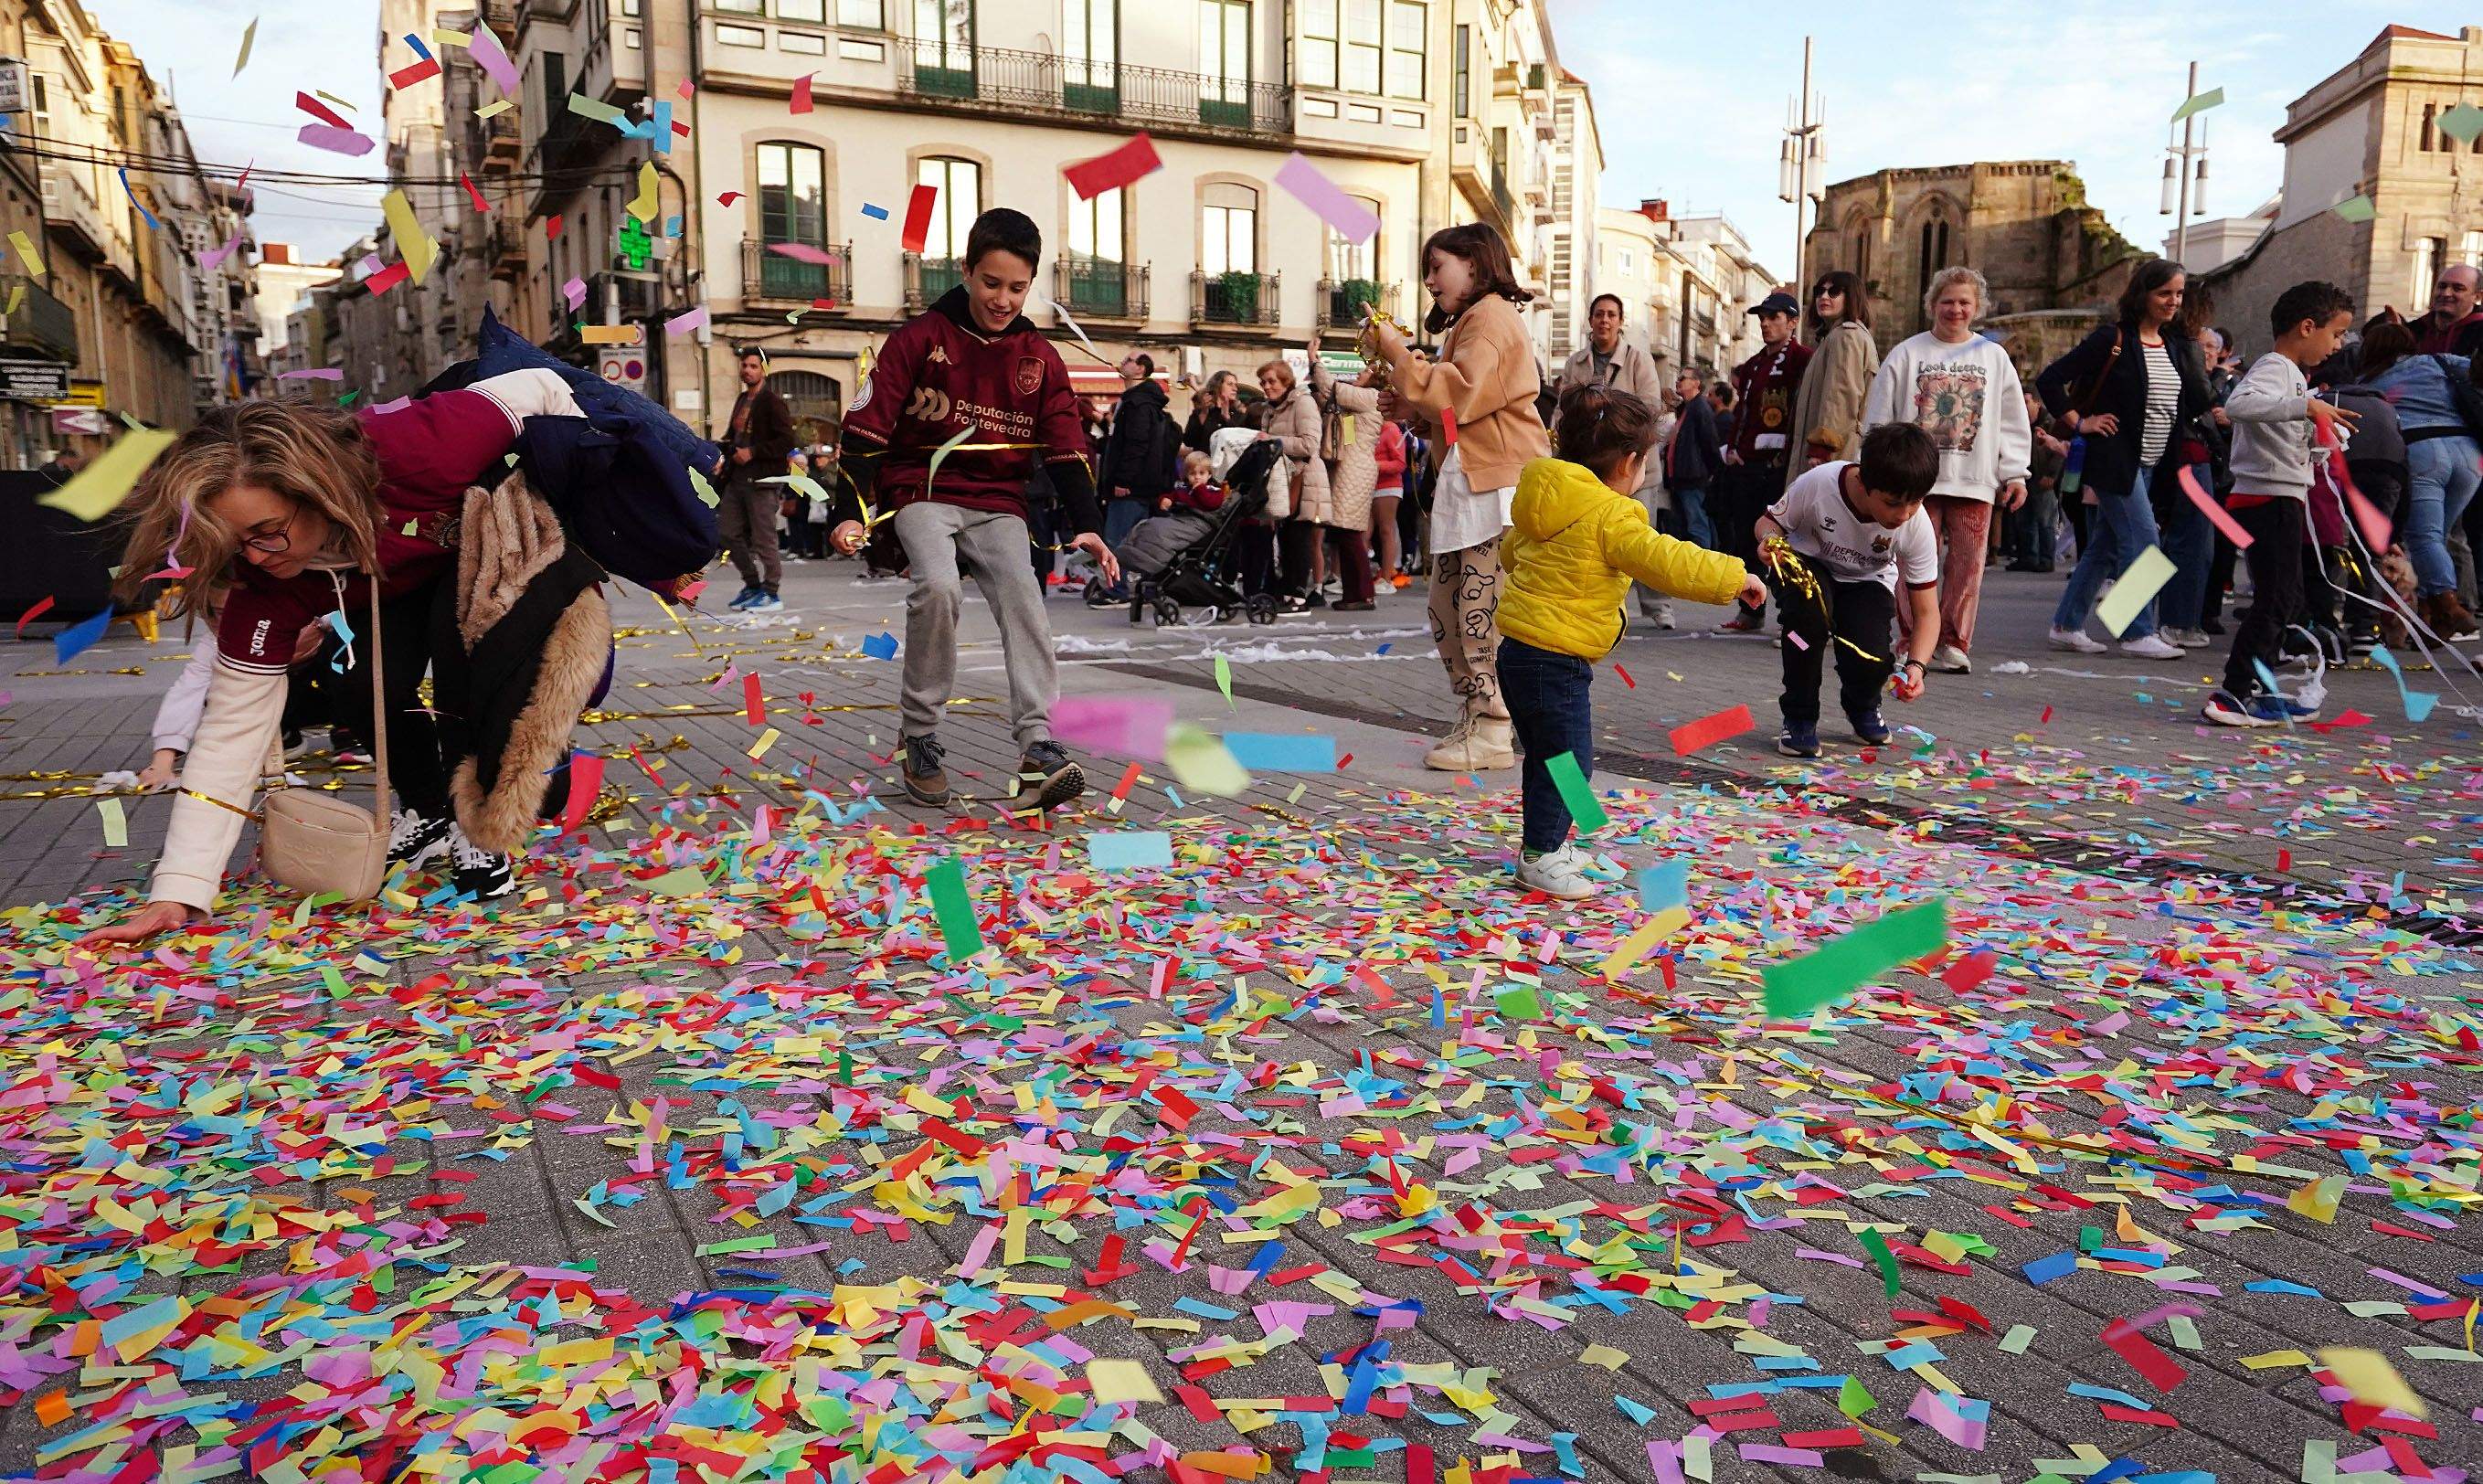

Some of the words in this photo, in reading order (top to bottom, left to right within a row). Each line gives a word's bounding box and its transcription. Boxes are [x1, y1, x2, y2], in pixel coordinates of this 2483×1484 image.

[953, 412, 1031, 439] Pontevedra
[956, 399, 1035, 426] Deputación
[1478, 646, 1492, 654] TASK
